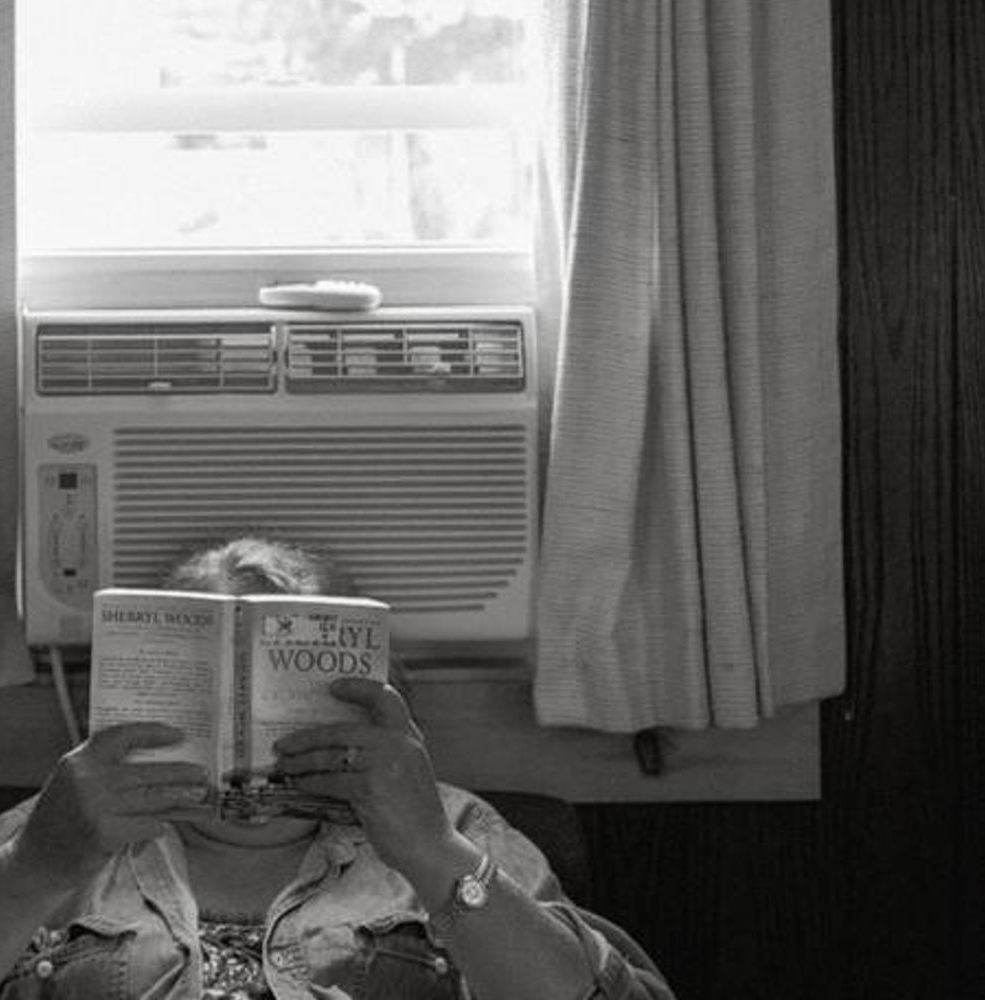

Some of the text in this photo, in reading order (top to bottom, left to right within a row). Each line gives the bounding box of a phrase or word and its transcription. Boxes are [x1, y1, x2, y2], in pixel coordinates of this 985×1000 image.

[101, 609, 215, 628] SHERRYL WOODS
[268, 648, 373, 675] WOODS
